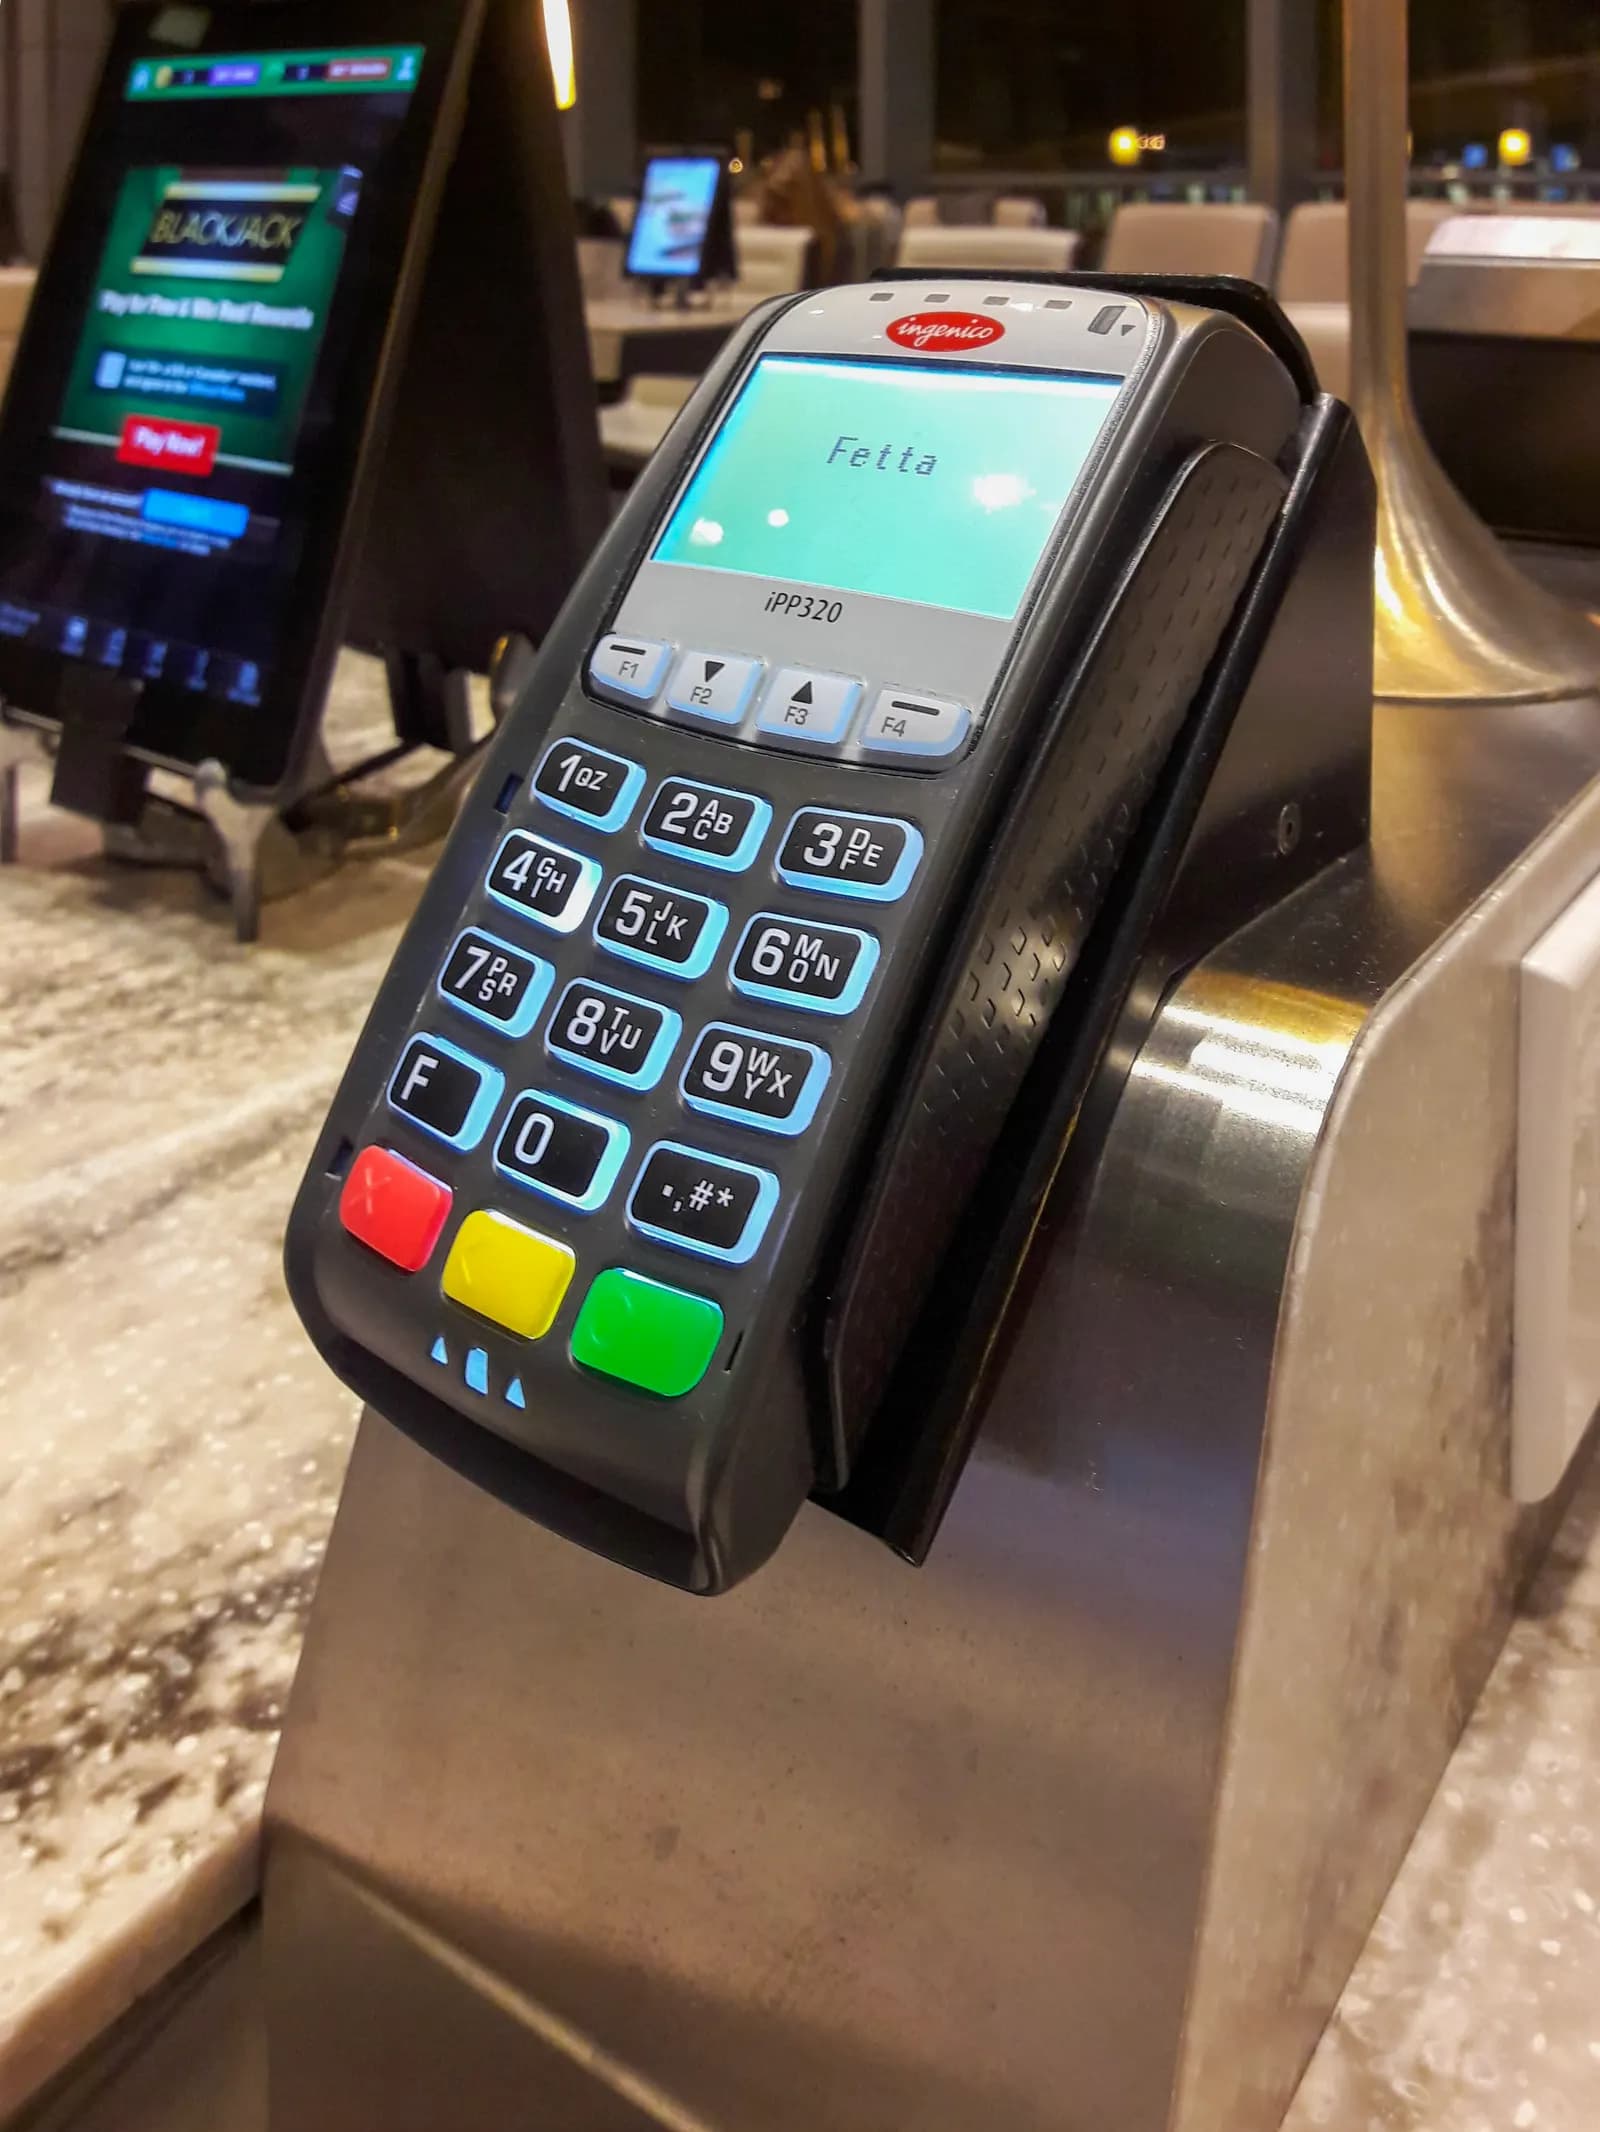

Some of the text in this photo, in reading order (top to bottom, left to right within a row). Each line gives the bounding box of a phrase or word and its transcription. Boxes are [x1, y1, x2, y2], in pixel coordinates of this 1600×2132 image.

[151, 208, 301, 249] BLACKJACK
[897, 317, 994, 347] ingenico
[826, 435, 938, 476] Fetta
[764, 591, 842, 624] iPP320
[618, 660, 640, 678] F1
[689, 685, 712, 705] F2
[783, 705, 809, 726] F3
[880, 716, 907, 738] F4
[401, 1053, 440, 1101] F
[513, 1112, 555, 1166] 0
